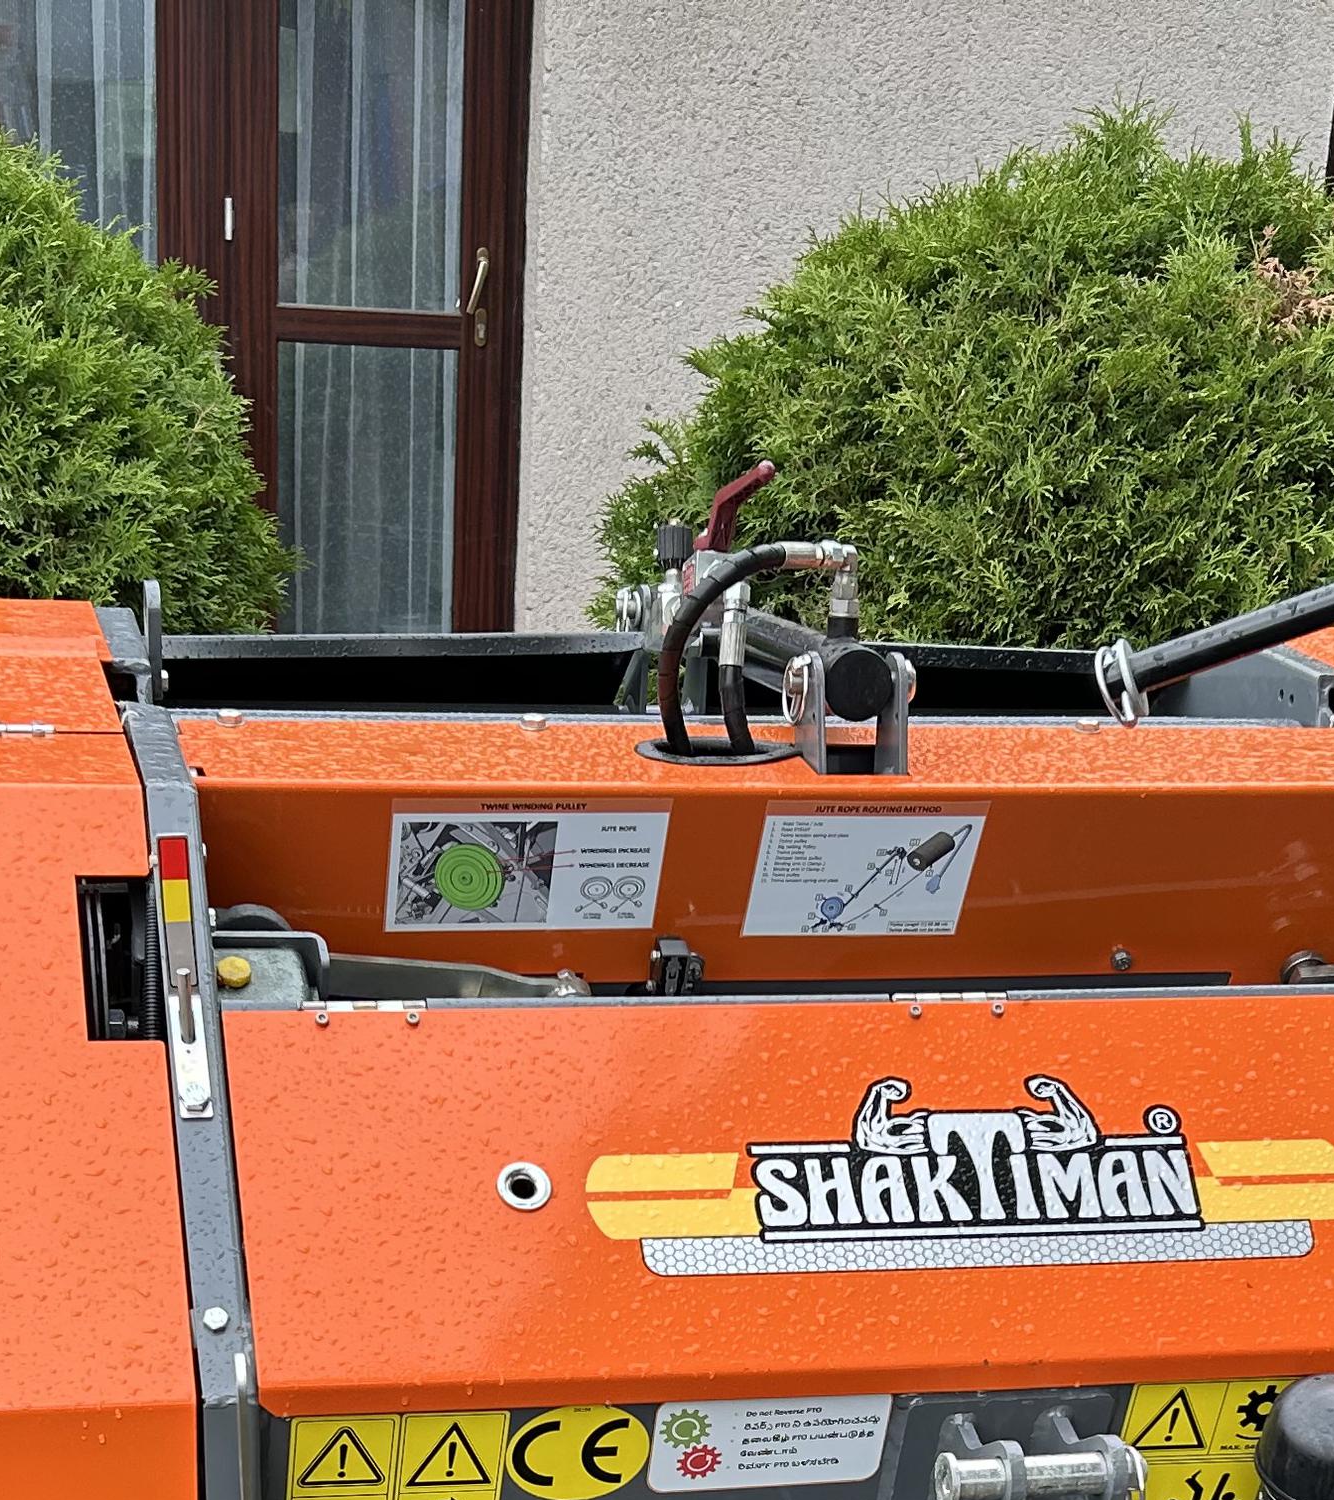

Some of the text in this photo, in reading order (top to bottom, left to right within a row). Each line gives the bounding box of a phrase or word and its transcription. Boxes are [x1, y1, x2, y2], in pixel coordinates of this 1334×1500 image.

[756, 1112, 1199, 1228] SHAKTIMAN
[774, 1408, 805, 1416] Reverse
[775, 1421, 791, 1429] PTO
[792, 1433, 807, 1441] PTO
[512, 1417, 629, 1486] CE
